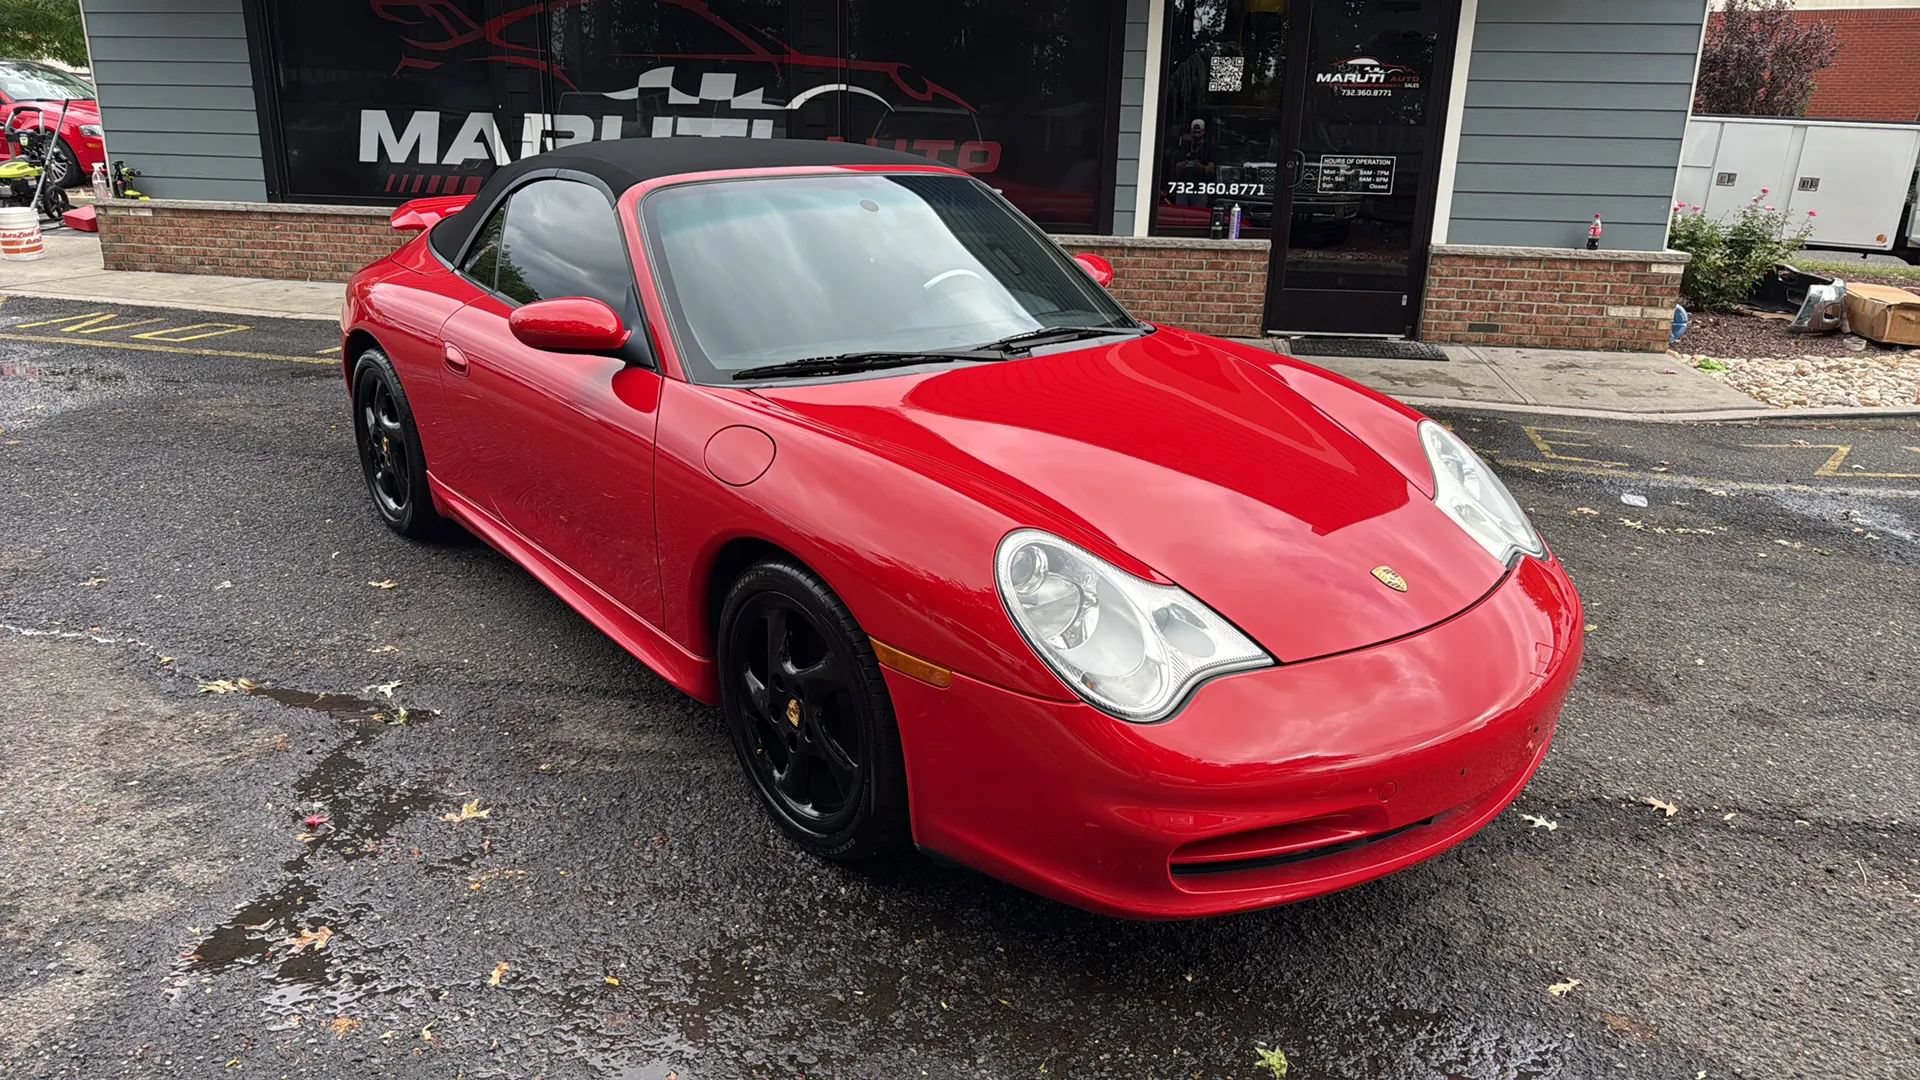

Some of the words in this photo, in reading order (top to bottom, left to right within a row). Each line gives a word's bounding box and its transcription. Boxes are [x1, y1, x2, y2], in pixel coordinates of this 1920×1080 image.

[1316, 73, 1385, 83] MARUTI
[1341, 89, 1392, 97] 732.360.8771
[1167, 181, 1265, 196] 732.360.8771
